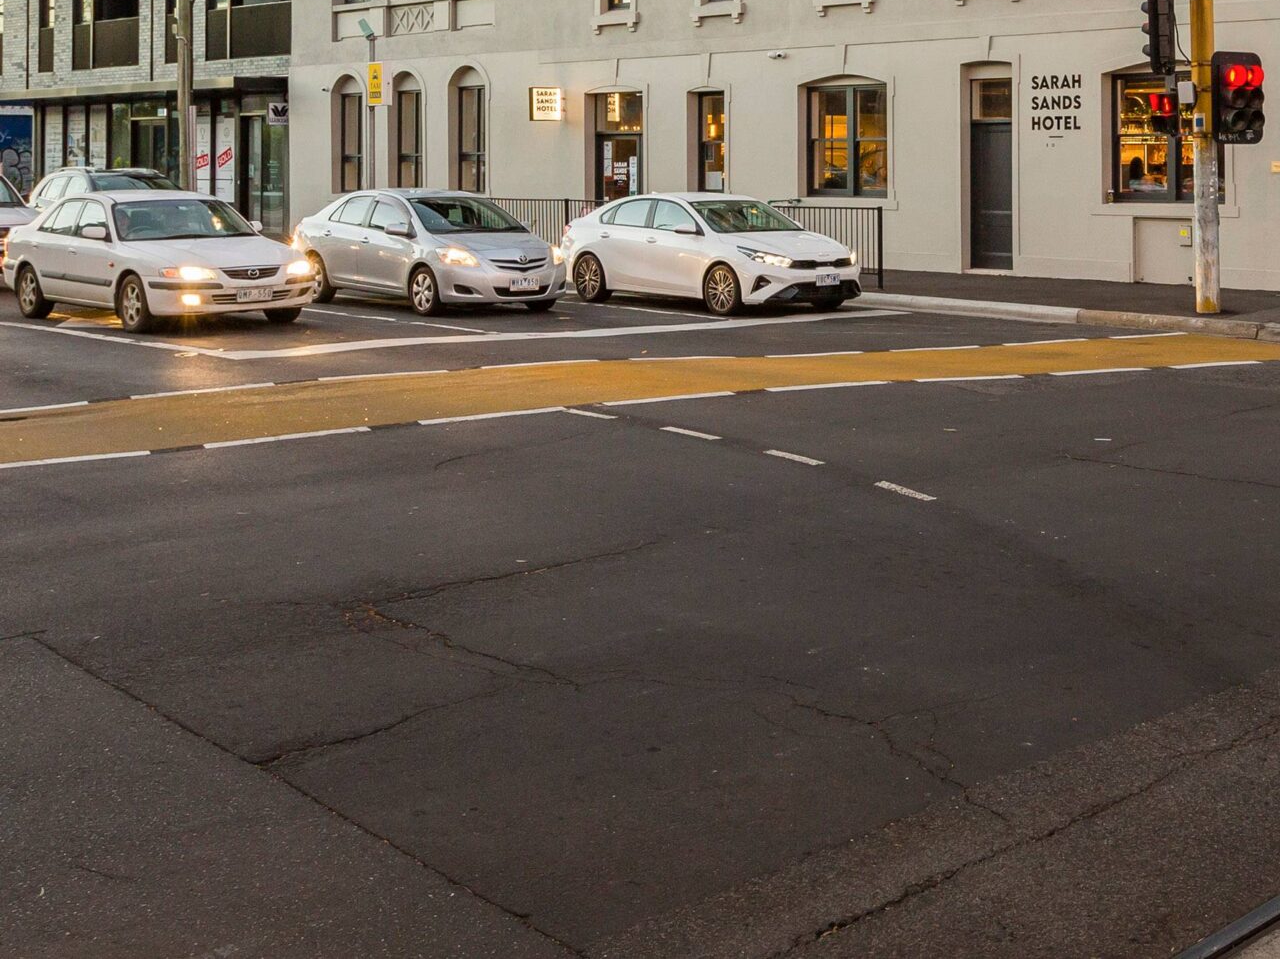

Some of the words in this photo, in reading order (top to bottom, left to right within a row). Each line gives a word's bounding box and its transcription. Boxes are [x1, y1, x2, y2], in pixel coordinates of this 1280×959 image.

[1031, 74, 1082, 90] SARAH
[1031, 95, 1082, 111] SANDS
[1031, 115, 1082, 131] HOTEL
[196, 155, 209, 166] OLD
[218, 150, 233, 166] SOLD
